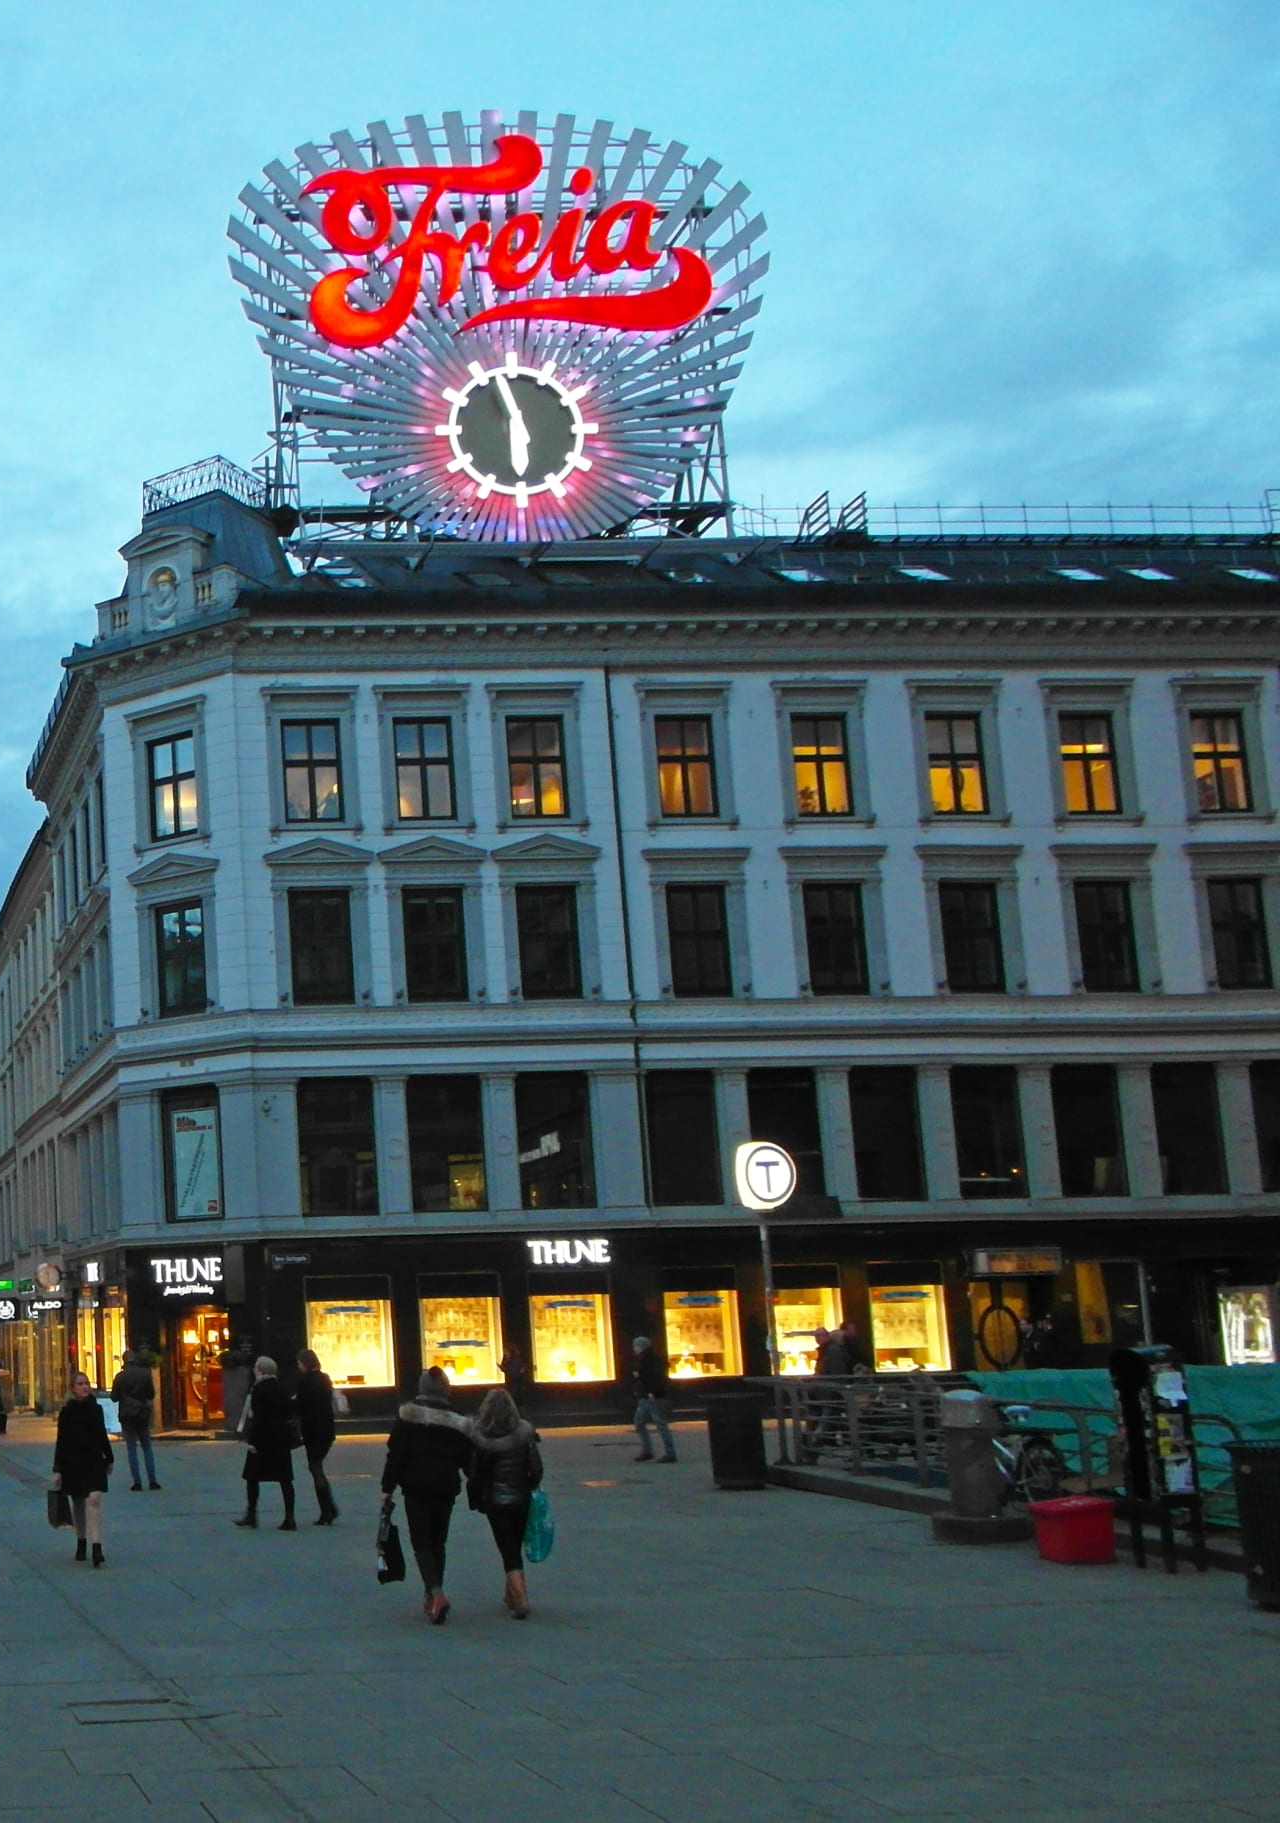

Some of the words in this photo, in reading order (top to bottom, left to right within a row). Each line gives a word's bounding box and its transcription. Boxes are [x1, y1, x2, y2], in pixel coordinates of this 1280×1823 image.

[299, 133, 712, 348] Freia
[527, 1239, 611, 1264] THUNE
[151, 1257, 223, 1283] THUNE
[33, 1301, 62, 1310] ALDO
